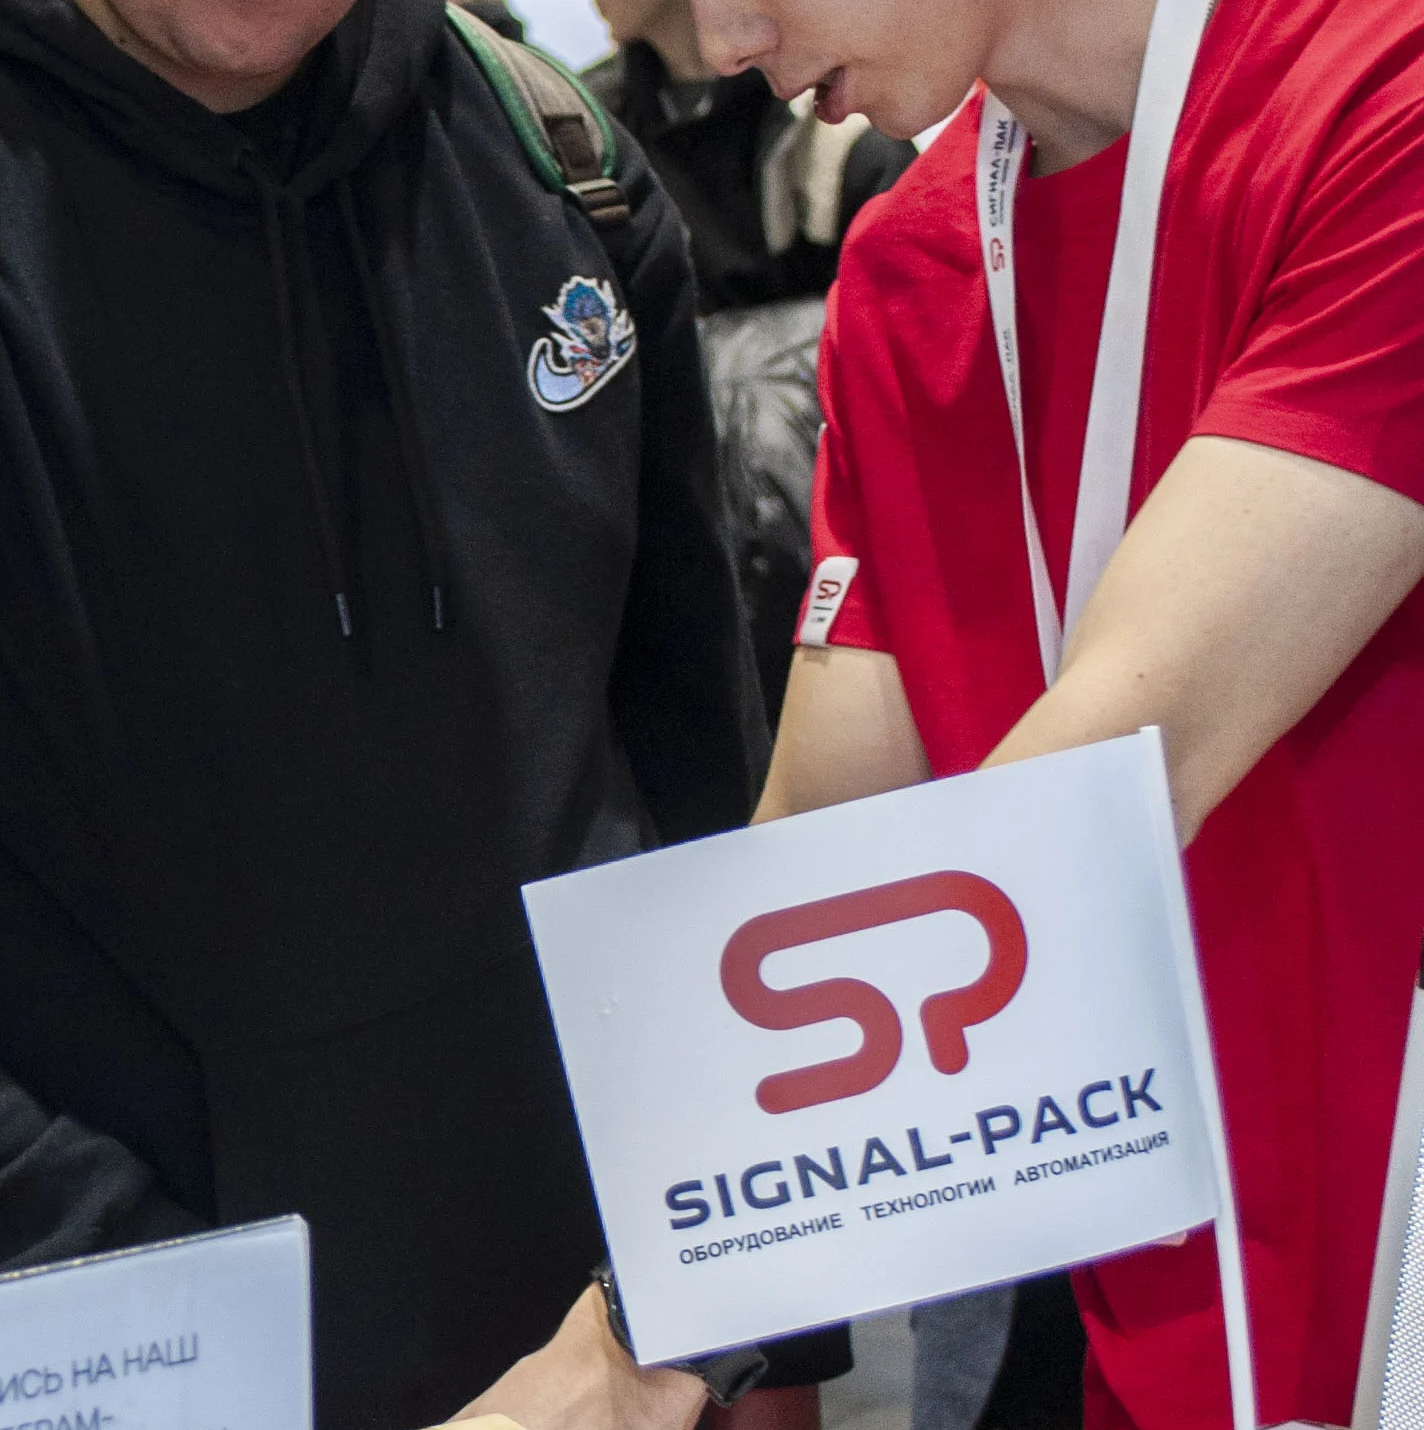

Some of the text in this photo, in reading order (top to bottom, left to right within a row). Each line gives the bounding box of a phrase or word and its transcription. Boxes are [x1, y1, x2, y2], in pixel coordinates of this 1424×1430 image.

[988, 119, 1009, 227] СИГНАЛ-ПАК
[720, 869, 1029, 1115] SP
[663, 1067, 1165, 1231] SIGNAL-PACK
[679, 1131, 1170, 1265] ОБОРУДОВАНИЕ ТЕХНОЛОГИИ АВТОМАТИЗАЦИЯ
[70, 1358, 117, 1391] НА
[122, 1333, 199, 1379] НАШ
